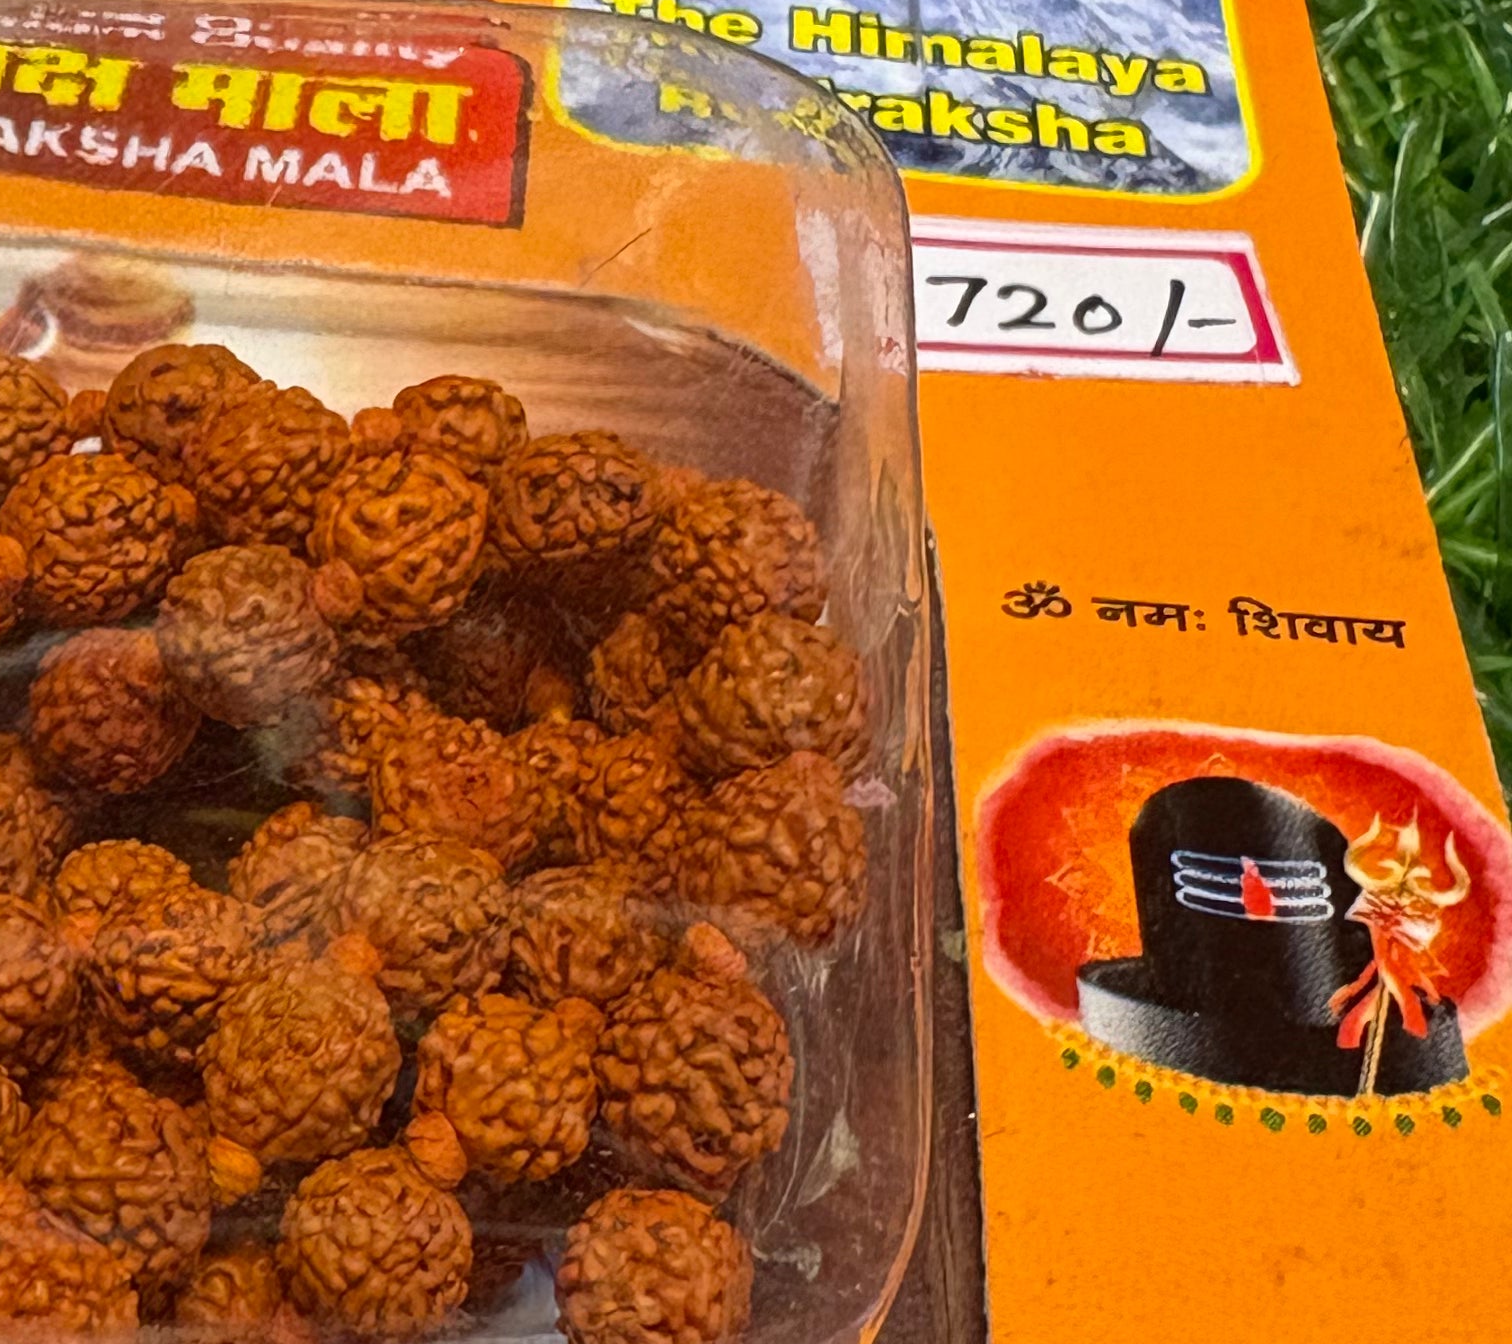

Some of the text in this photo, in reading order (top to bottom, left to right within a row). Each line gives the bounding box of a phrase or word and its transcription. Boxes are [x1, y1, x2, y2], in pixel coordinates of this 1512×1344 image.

[787, 2, 1212, 99] Himalaya
[171, 60, 474, 145] माला
[243, 143, 455, 199] MALA
[1090, 597, 1207, 633] नमः
[1227, 596, 1407, 650] शिवाय
